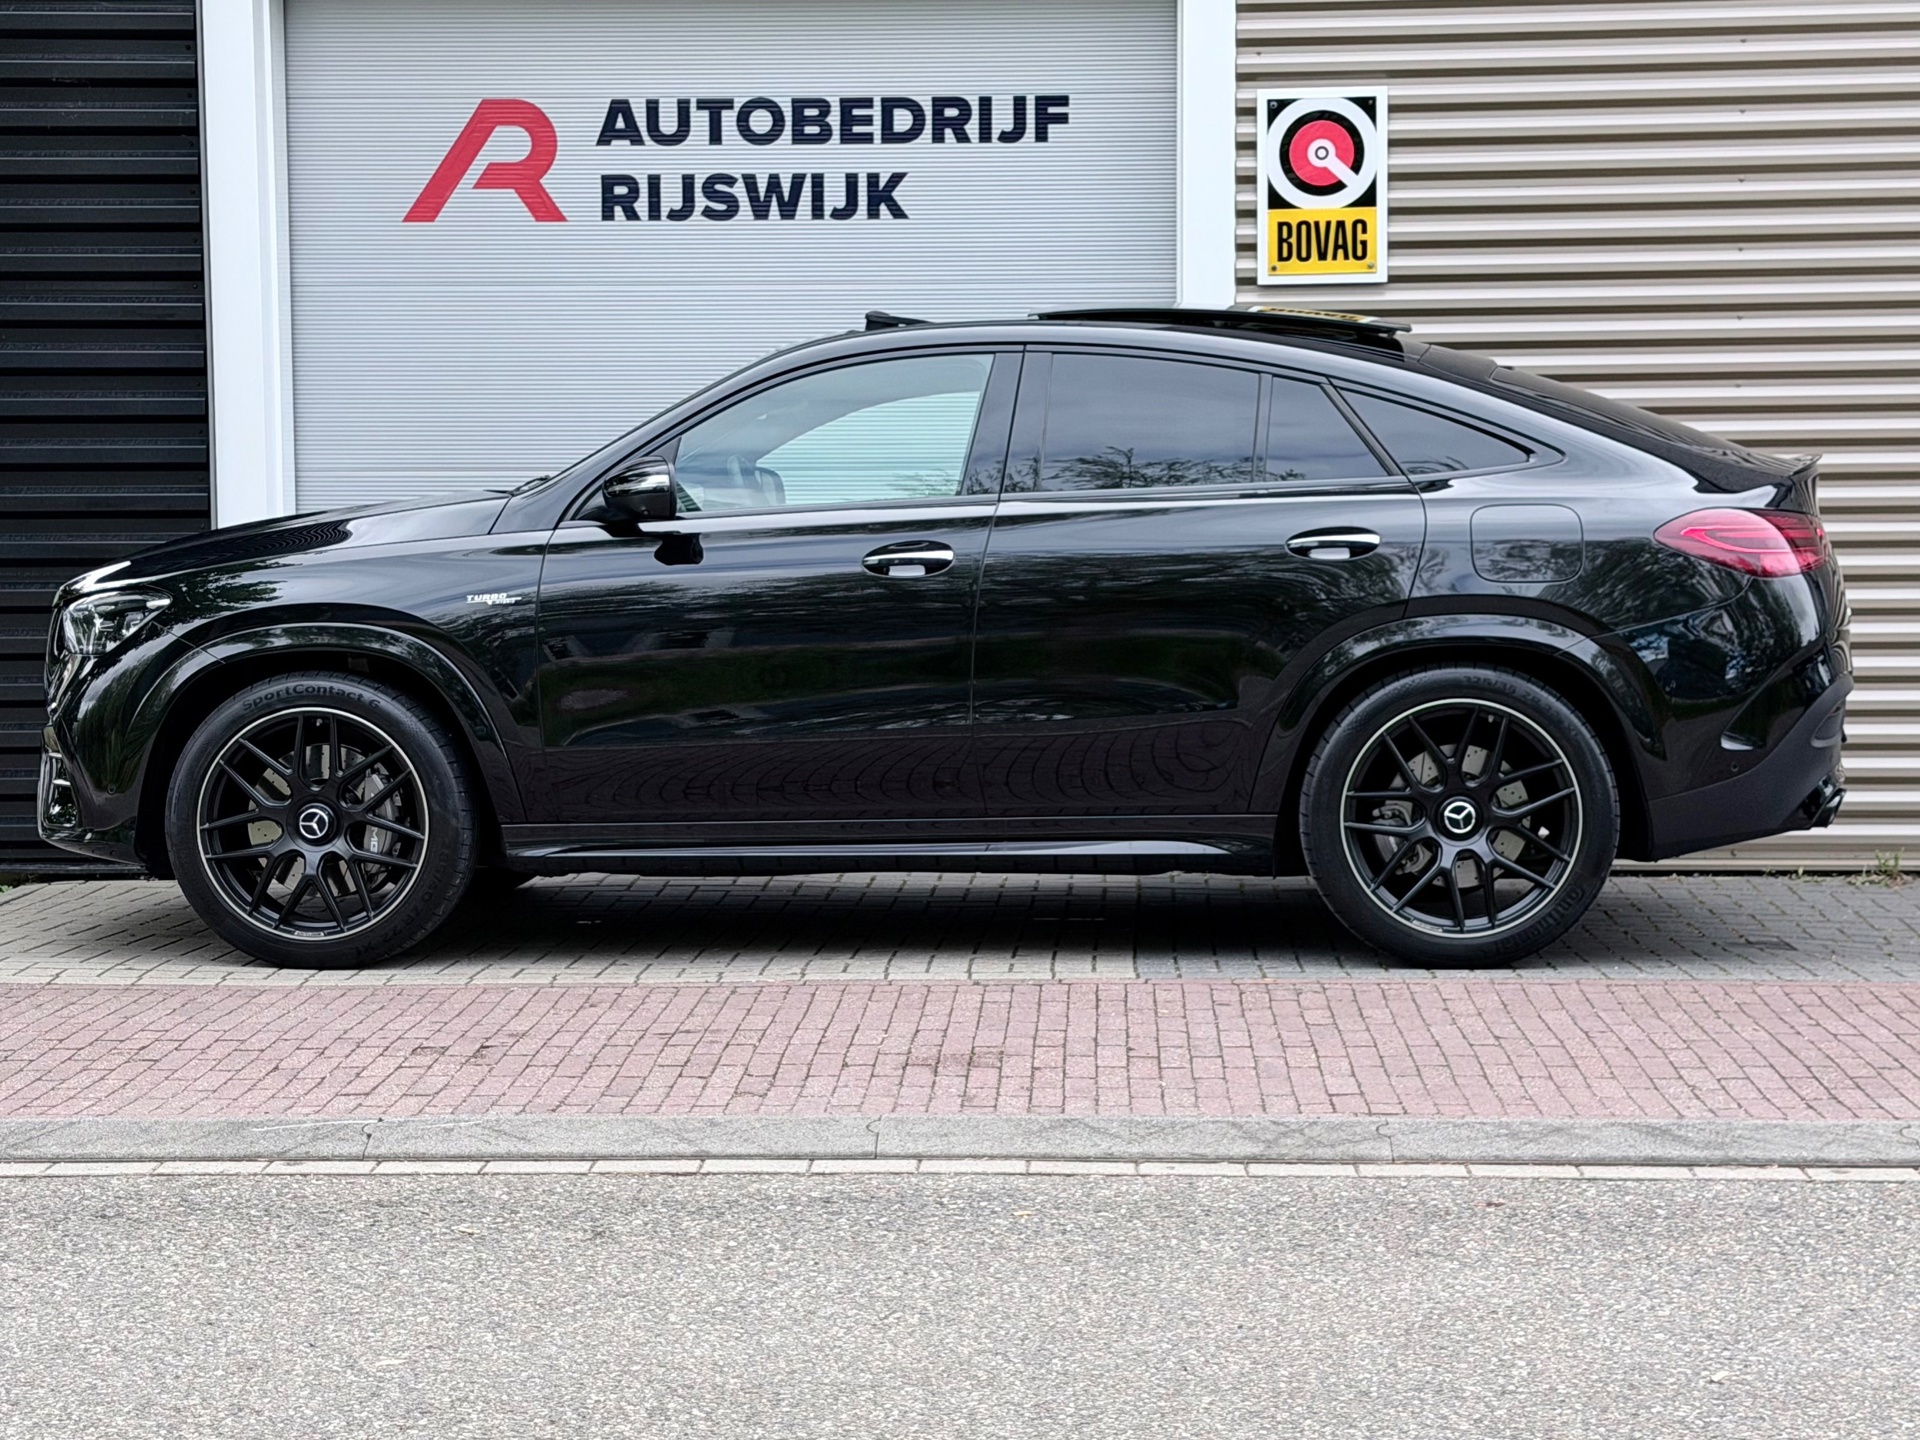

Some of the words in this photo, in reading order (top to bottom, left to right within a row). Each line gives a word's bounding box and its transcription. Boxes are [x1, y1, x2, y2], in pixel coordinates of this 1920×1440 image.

[597, 95, 1071, 147] AUTOBEDRIJF
[600, 172, 910, 222] RIJSWIJK
[1277, 219, 1368, 262] BOVAG
[466, 593, 508, 603] TURBO
[242, 683, 366, 712] SportContact
